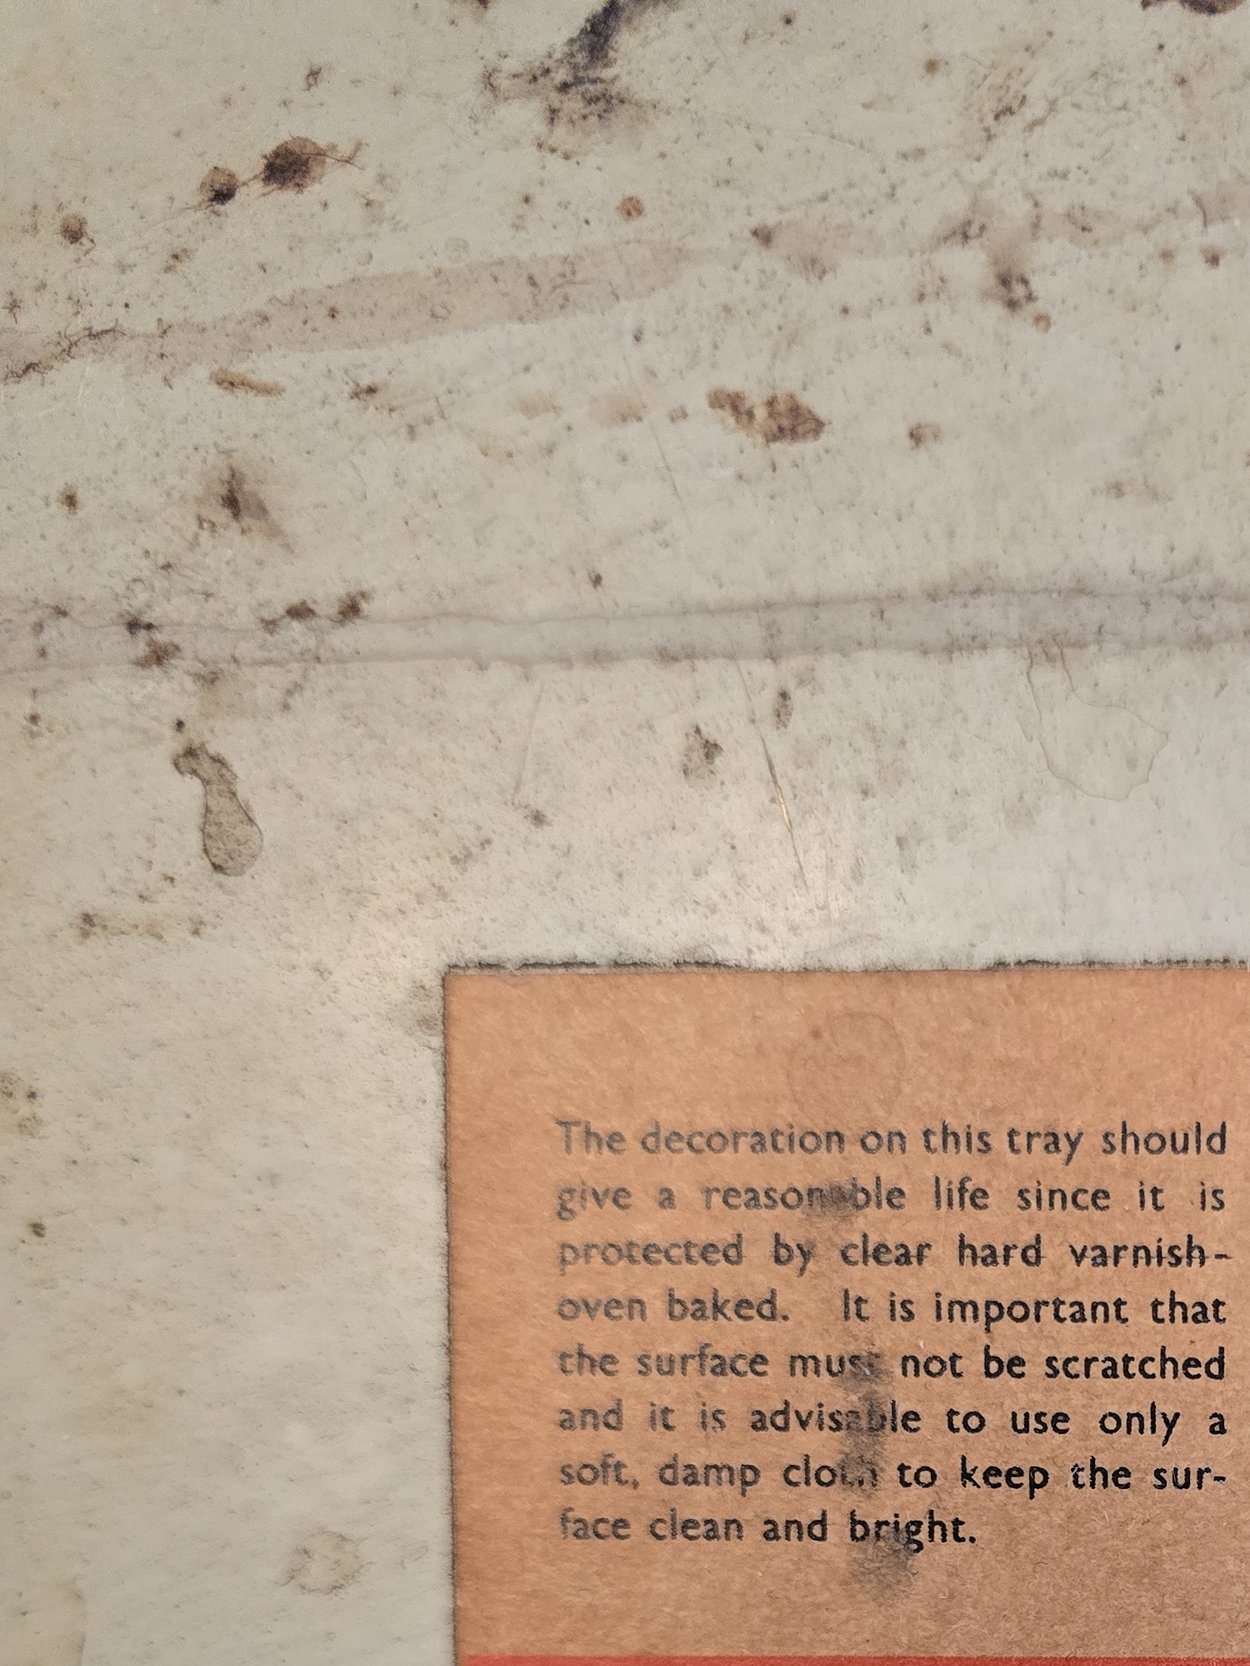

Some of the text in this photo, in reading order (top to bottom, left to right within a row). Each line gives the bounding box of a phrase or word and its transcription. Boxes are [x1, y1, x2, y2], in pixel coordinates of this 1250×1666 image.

[557, 1121, 1227, 1165] The decoration on this tray should
[557, 1178, 1225, 1220] give a reasonble life since it is
[558, 1234, 1230, 1275] protected by clear hard varnish-
[557, 1290, 1226, 1331] oven baked. It is important that
[558, 1345, 618, 1377] the
[637, 1345, 768, 1377] surface
[901, 1350, 962, 1377] not
[983, 1346, 1026, 1379] be
[1044, 1346, 1226, 1380] scratched
[558, 1400, 623, 1432] and
[649, 1403, 675, 1432] it
[700, 1403, 726, 1432] is
[947, 1408, 986, 1433] to
[1011, 1410, 1070, 1434] use
[1099, 1402, 1181, 1445] only
[1208, 1412, 1227, 1436] a
[559, 1453, 638, 1489] soft,
[659, 1454, 761, 1497] damp
[897, 1462, 936, 1487] to
[961, 1456, 1049, 1499] keep
[1070, 1457, 1131, 1489] the
[1153, 1466, 1227, 1490] sur-
[559, 1507, 976, 1552] face clean and bright.
